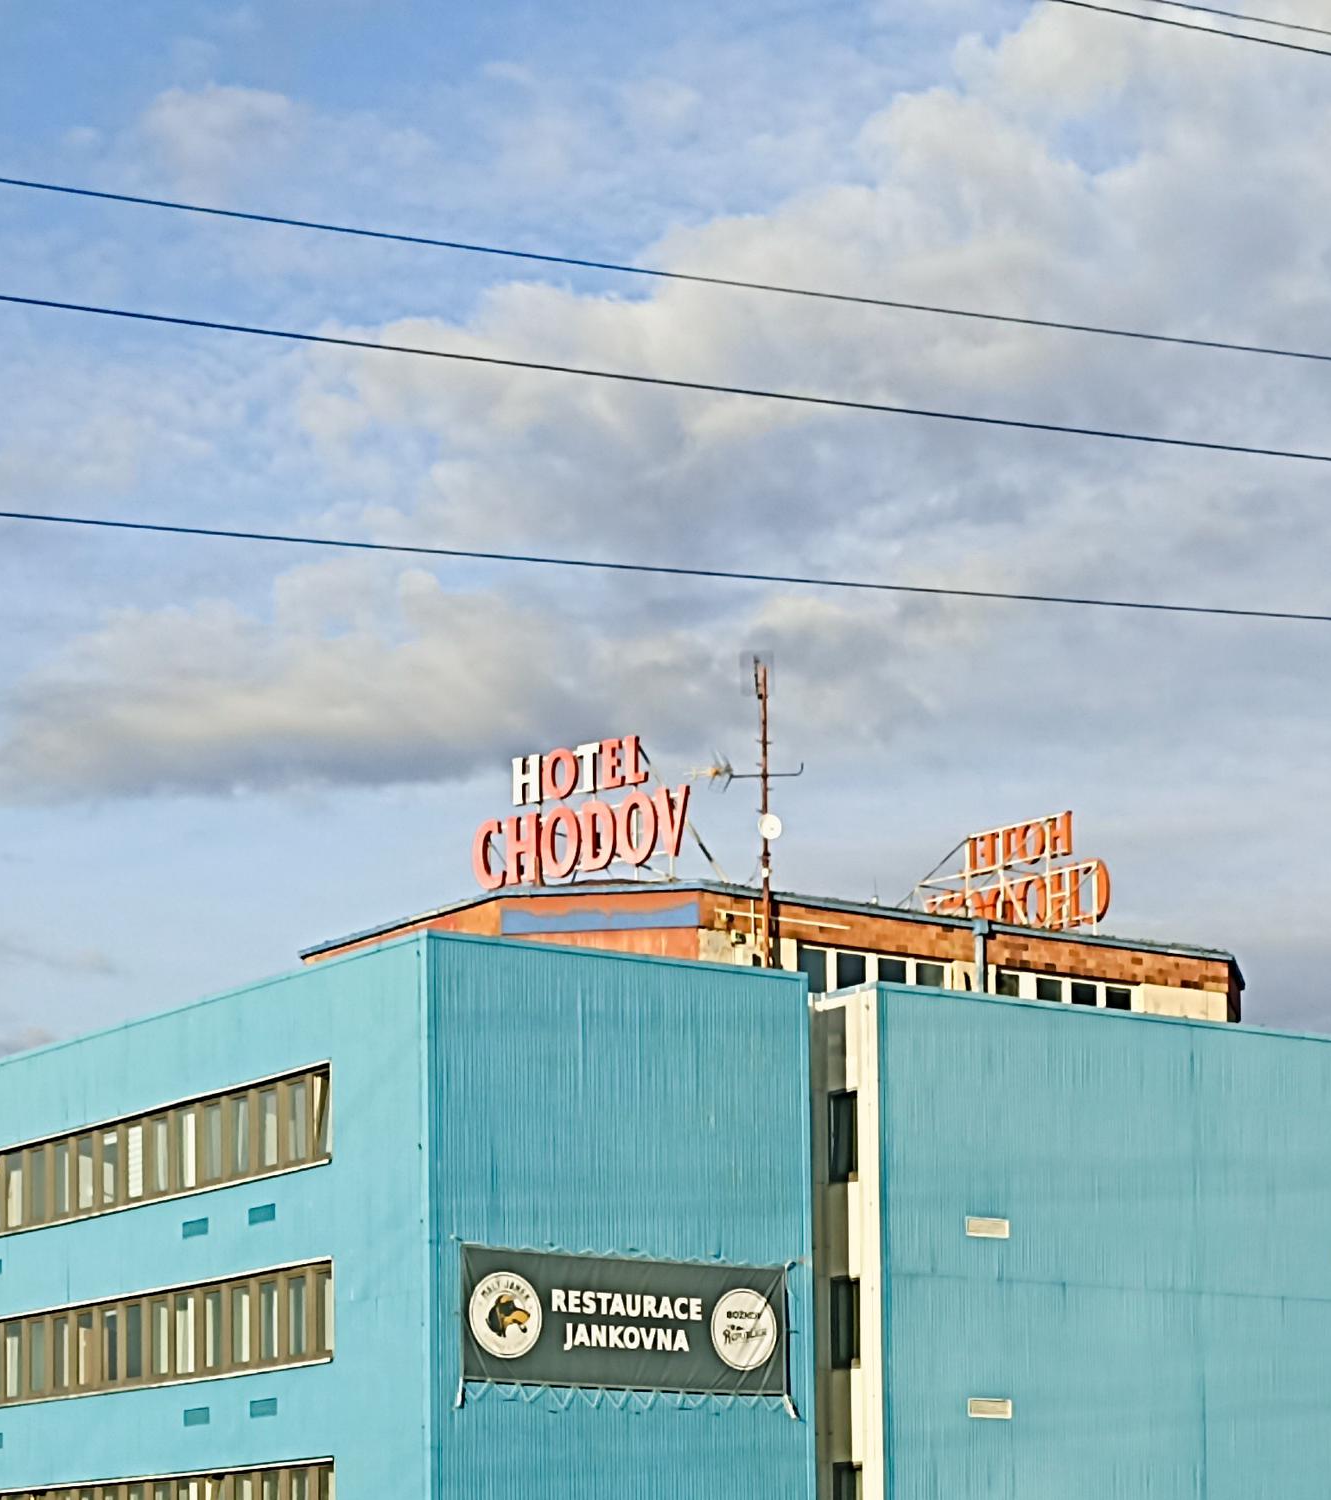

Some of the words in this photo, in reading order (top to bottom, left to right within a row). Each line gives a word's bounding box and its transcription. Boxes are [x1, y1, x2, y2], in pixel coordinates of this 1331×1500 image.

[512, 735, 649, 806] HOTEL
[472, 784, 690, 890] CHODOV
[551, 1288, 703, 1321] RESTAURACE
[563, 1322, 690, 1352] JANKOVNA
